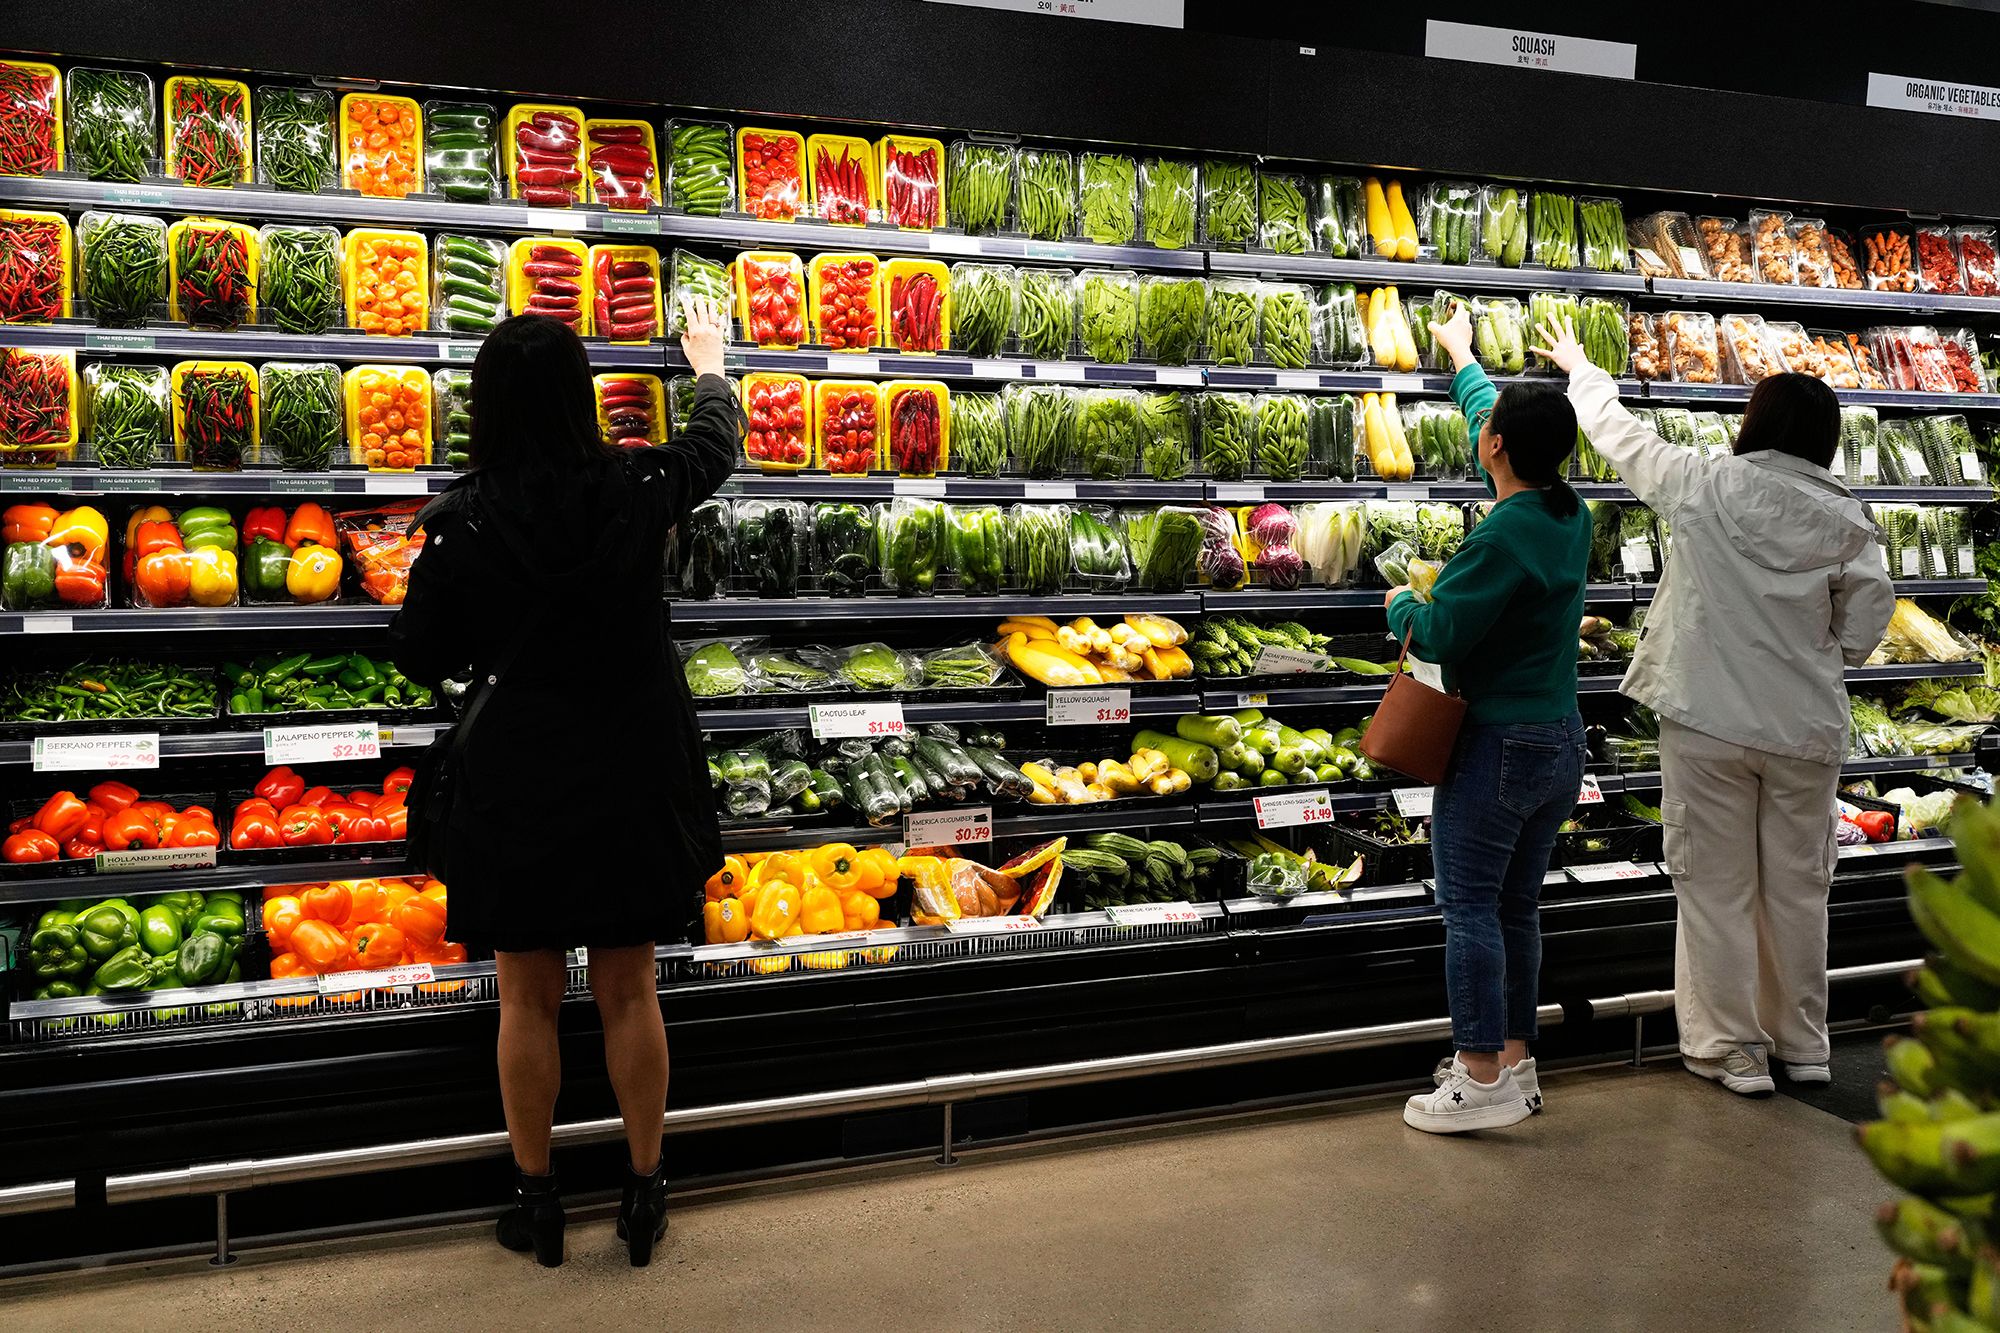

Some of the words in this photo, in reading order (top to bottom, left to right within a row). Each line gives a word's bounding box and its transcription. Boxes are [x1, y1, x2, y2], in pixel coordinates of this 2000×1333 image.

[1037, 1, 1052, 11] 오이
[1512, 35, 1556, 56] SQUASH
[1517, 55, 1530, 65] 호박
[1906, 82, 1946, 102] ORGANIC
[1947, 87, 2000, 108] VEGETABLES
[1055, 696, 1081, 704] YELLOW
[1081, 696, 1110, 704] SQUASH
[819, 710, 848, 718] CACTUS
[848, 709, 867, 717] LEAF
[1096, 708, 1129, 721] $1.99
[868, 720, 903, 734] $1.49
[275, 732, 320, 742] JALAPENO
[321, 731, 355, 740] PEPPER
[47, 742, 94, 750] SERRANO
[95, 741, 132, 749] PEPPER
[332, 744, 377, 758] $2.49
[1578, 790, 1601, 801] 2.49
[911, 818, 939, 826] AMERICA
[940, 815, 973, 824] CUCUMBER
[1303, 808, 1332, 822] $1.49
[955, 827, 990, 842] $0.79
[107, 855, 152, 863] HOLLAND
[172, 852, 208, 860] PEPPER
[1615, 869, 1643, 878] $1.49
[1164, 912, 1197, 921] $1.99
[387, 973, 431, 985] $3.99
